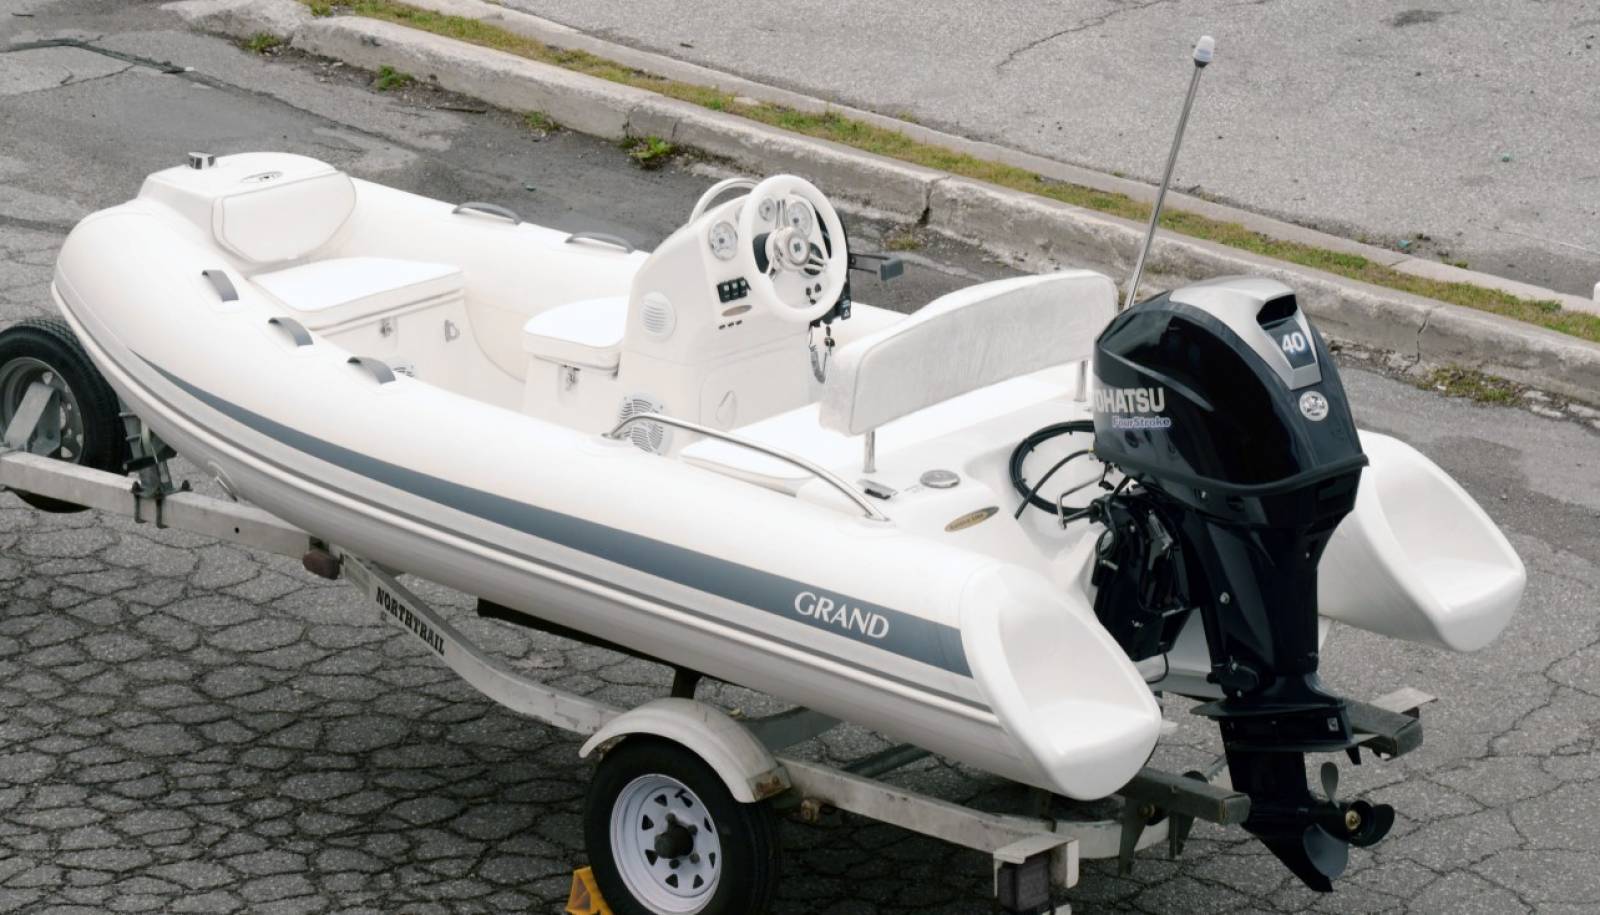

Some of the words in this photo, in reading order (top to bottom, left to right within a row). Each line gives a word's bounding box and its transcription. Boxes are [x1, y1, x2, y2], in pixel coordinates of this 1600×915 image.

[1282, 331, 1306, 354] 40
[1094, 387, 1166, 413] OHATSU
[376, 586, 445, 656] NORTHTRAIL
[794, 591, 889, 639] GRAND
